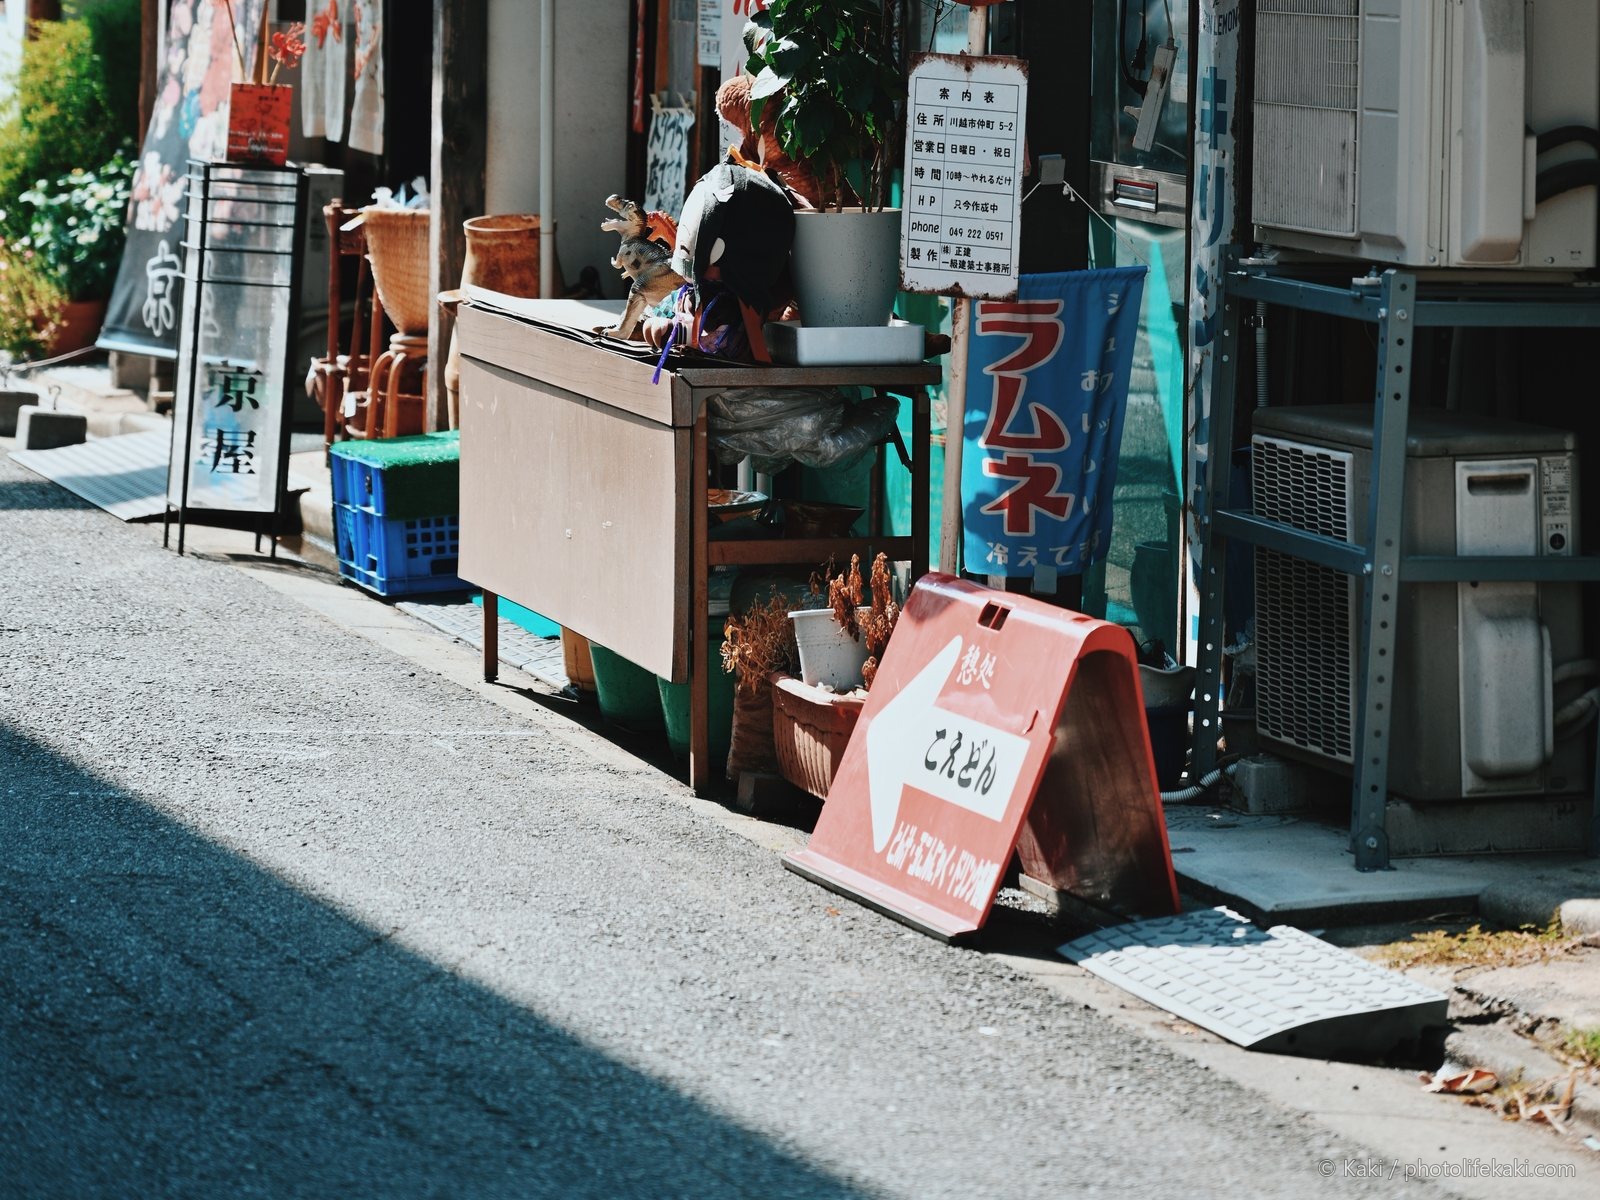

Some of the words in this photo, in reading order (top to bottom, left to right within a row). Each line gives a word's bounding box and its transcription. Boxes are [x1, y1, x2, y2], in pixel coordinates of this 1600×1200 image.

[1213, 6, 1238, 36] LEMON
[939, 87, 995, 104] 案内表
[917, 112, 944, 127] 住所
[949, 117, 995, 130] 川越市仲町
[999, 121, 1014, 132] 5-2
[914, 140, 945, 154] 営業日
[914, 167, 942, 181] 時間
[953, 199, 998, 214] 只今作成中
[911, 221, 940, 234] phone
[949, 227, 963, 237] 049
[967, 229, 981, 239] 222
[985, 231, 1004, 241] 0591
[910, 247, 938, 262] 製作
[941, 259, 1010, 274] 一級建築士事務所
[209, 359, 263, 476] 京屋
[975, 300, 1076, 537] ラムネ
[956, 644, 997, 690] 憩処
[924, 728, 997, 796] こえどん
